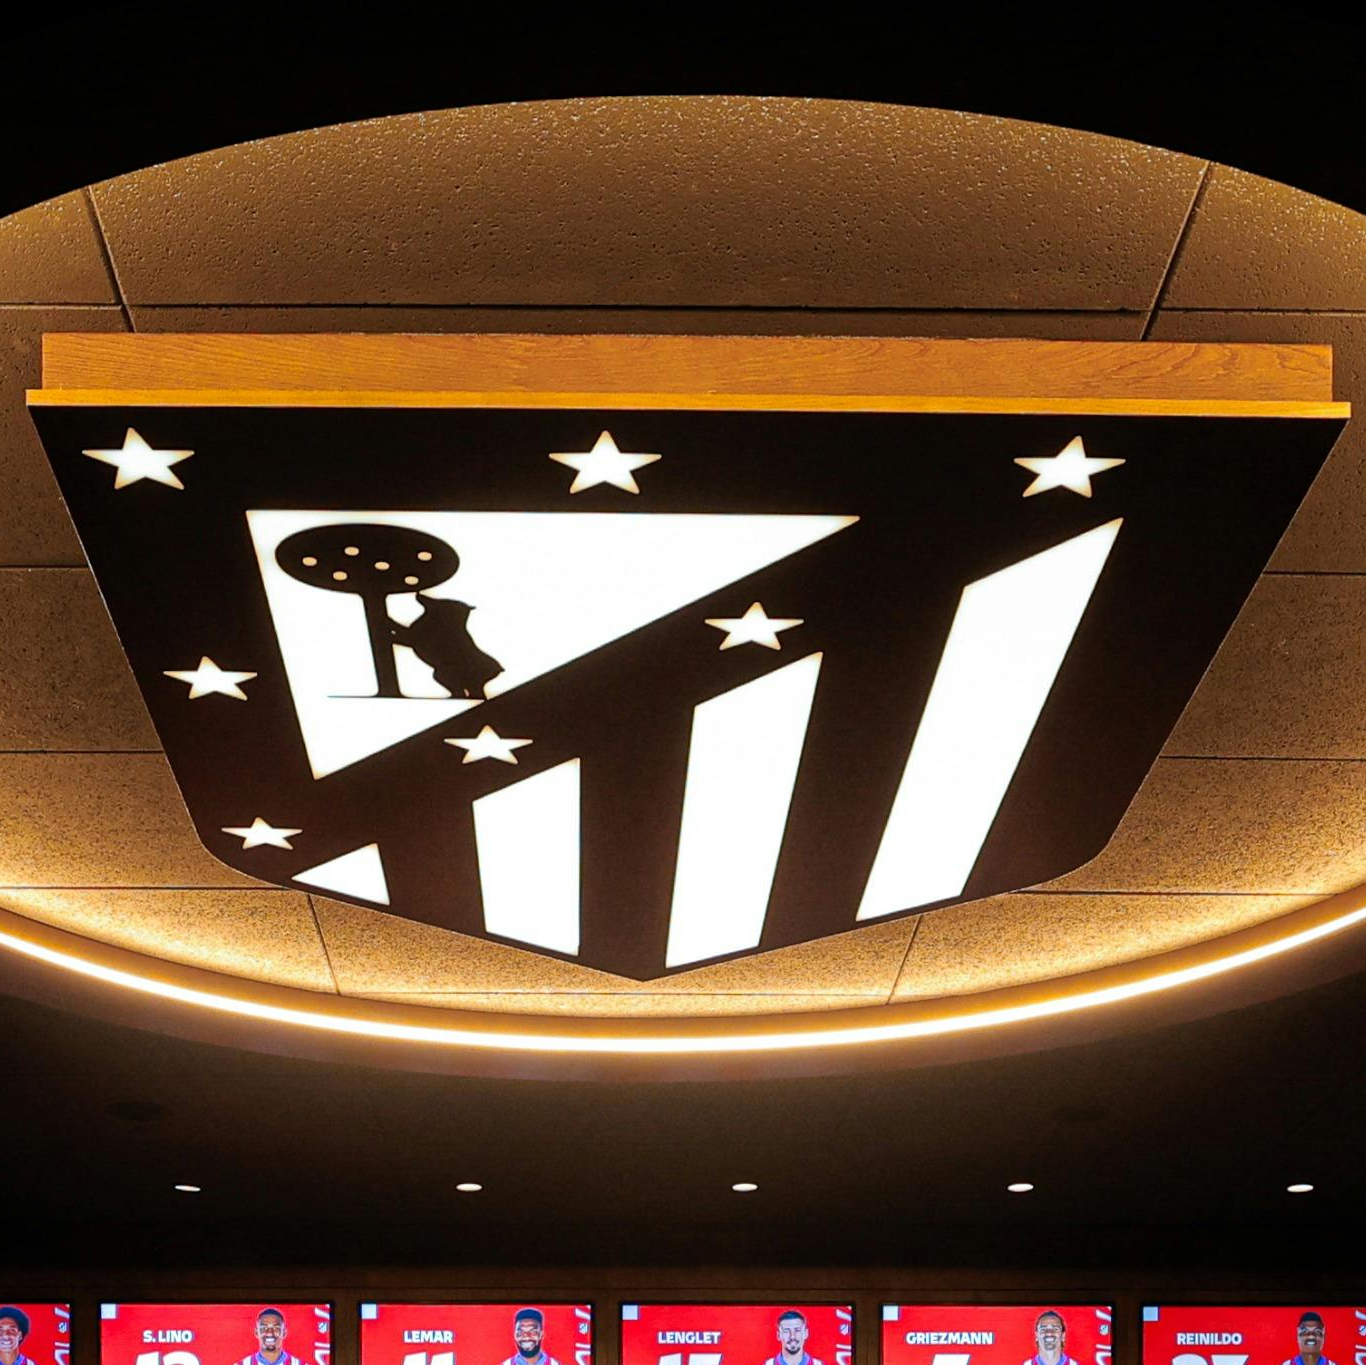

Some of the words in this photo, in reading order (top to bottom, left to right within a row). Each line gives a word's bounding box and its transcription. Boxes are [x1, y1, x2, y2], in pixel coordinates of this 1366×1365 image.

[142, 1329, 157, 1343] S.
[158, 1329, 193, 1343] LINO
[403, 1330, 454, 1344] LEMAR
[657, 1331, 721, 1345] LENGLET
[905, 1331, 993, 1345] GRIEZMANN
[1177, 1332, 1243, 1345] REINILDO
